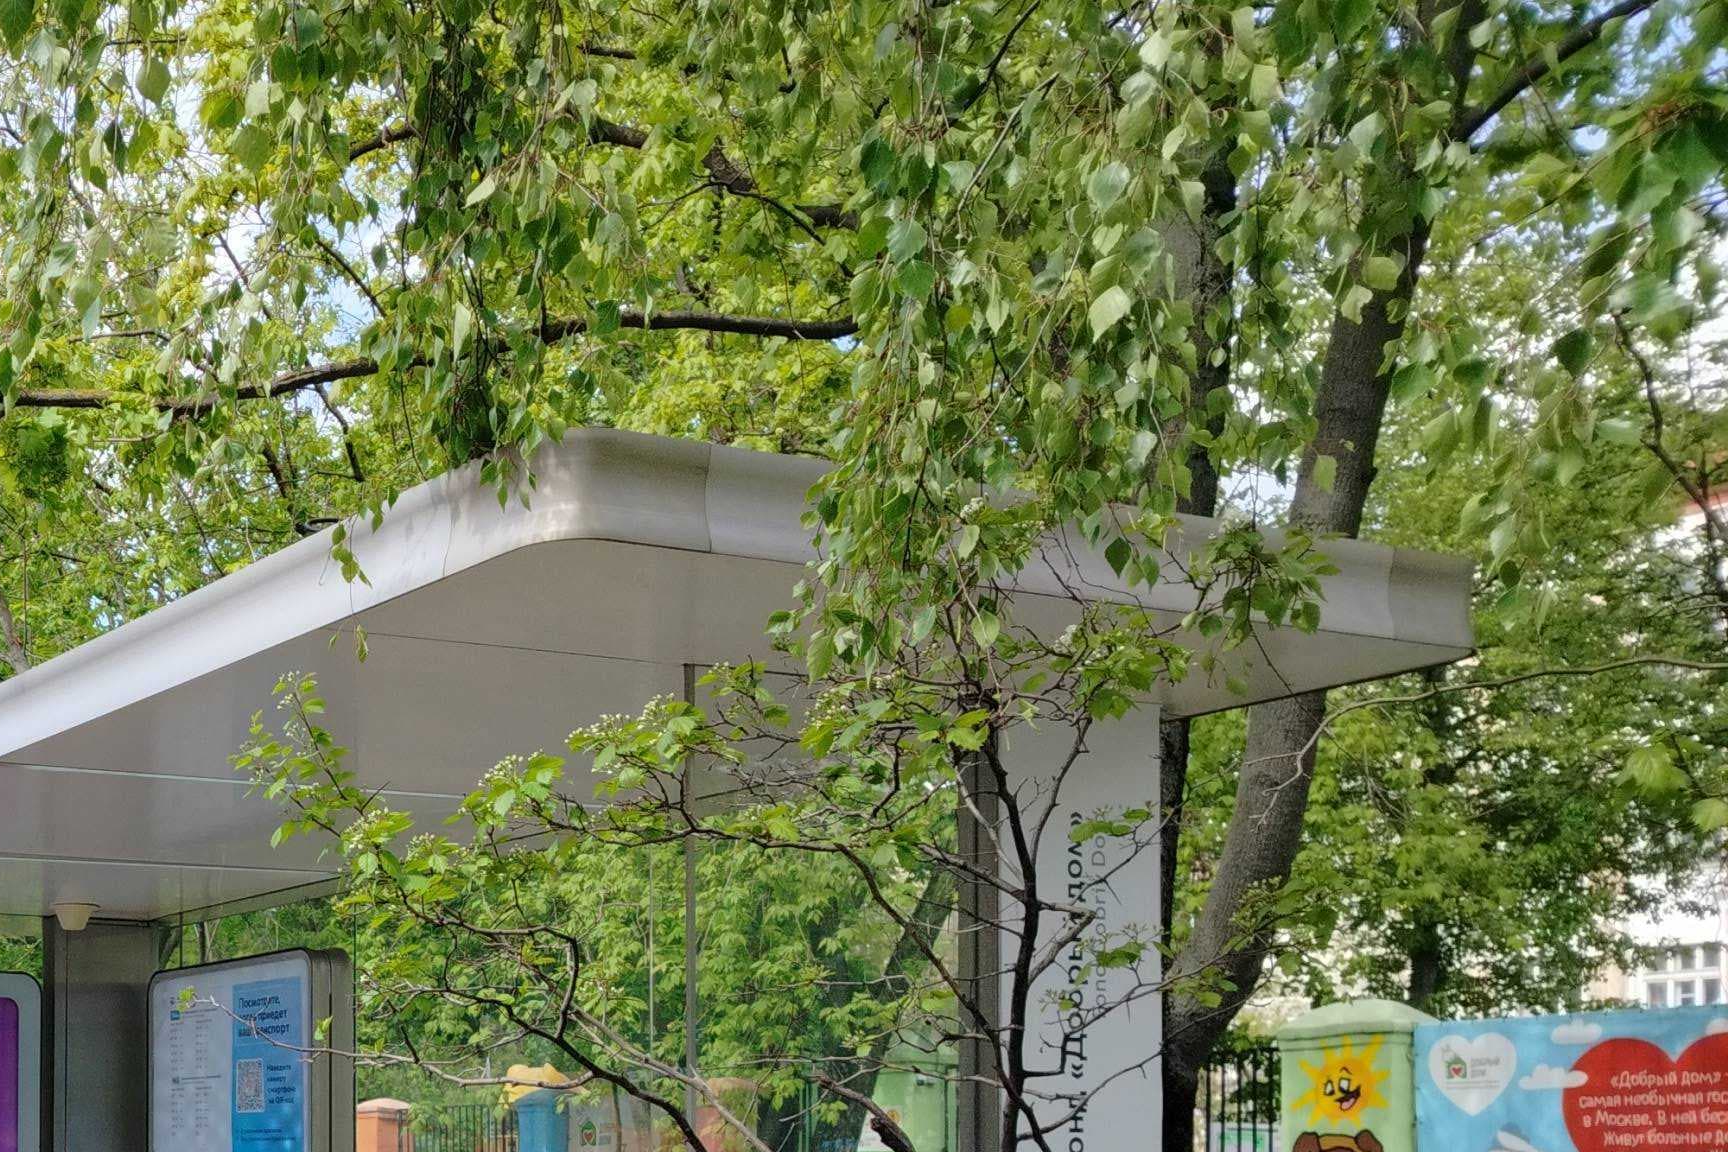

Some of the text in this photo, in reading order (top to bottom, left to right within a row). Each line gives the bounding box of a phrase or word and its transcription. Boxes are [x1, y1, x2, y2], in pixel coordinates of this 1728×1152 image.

[1610, 1070, 1721, 1089] «Добрый дом»
[1579, 1094, 1621, 1108] самая
[1624, 1089, 1703, 1106] необычная
[1583, 1114, 1592, 1128] в
[1594, 1110, 1653, 1127] Москве.
[1657, 1110, 1667, 1126] В
[1670, 1109, 1697, 1125] ней
[1647, 1127, 1713, 1145] больные
